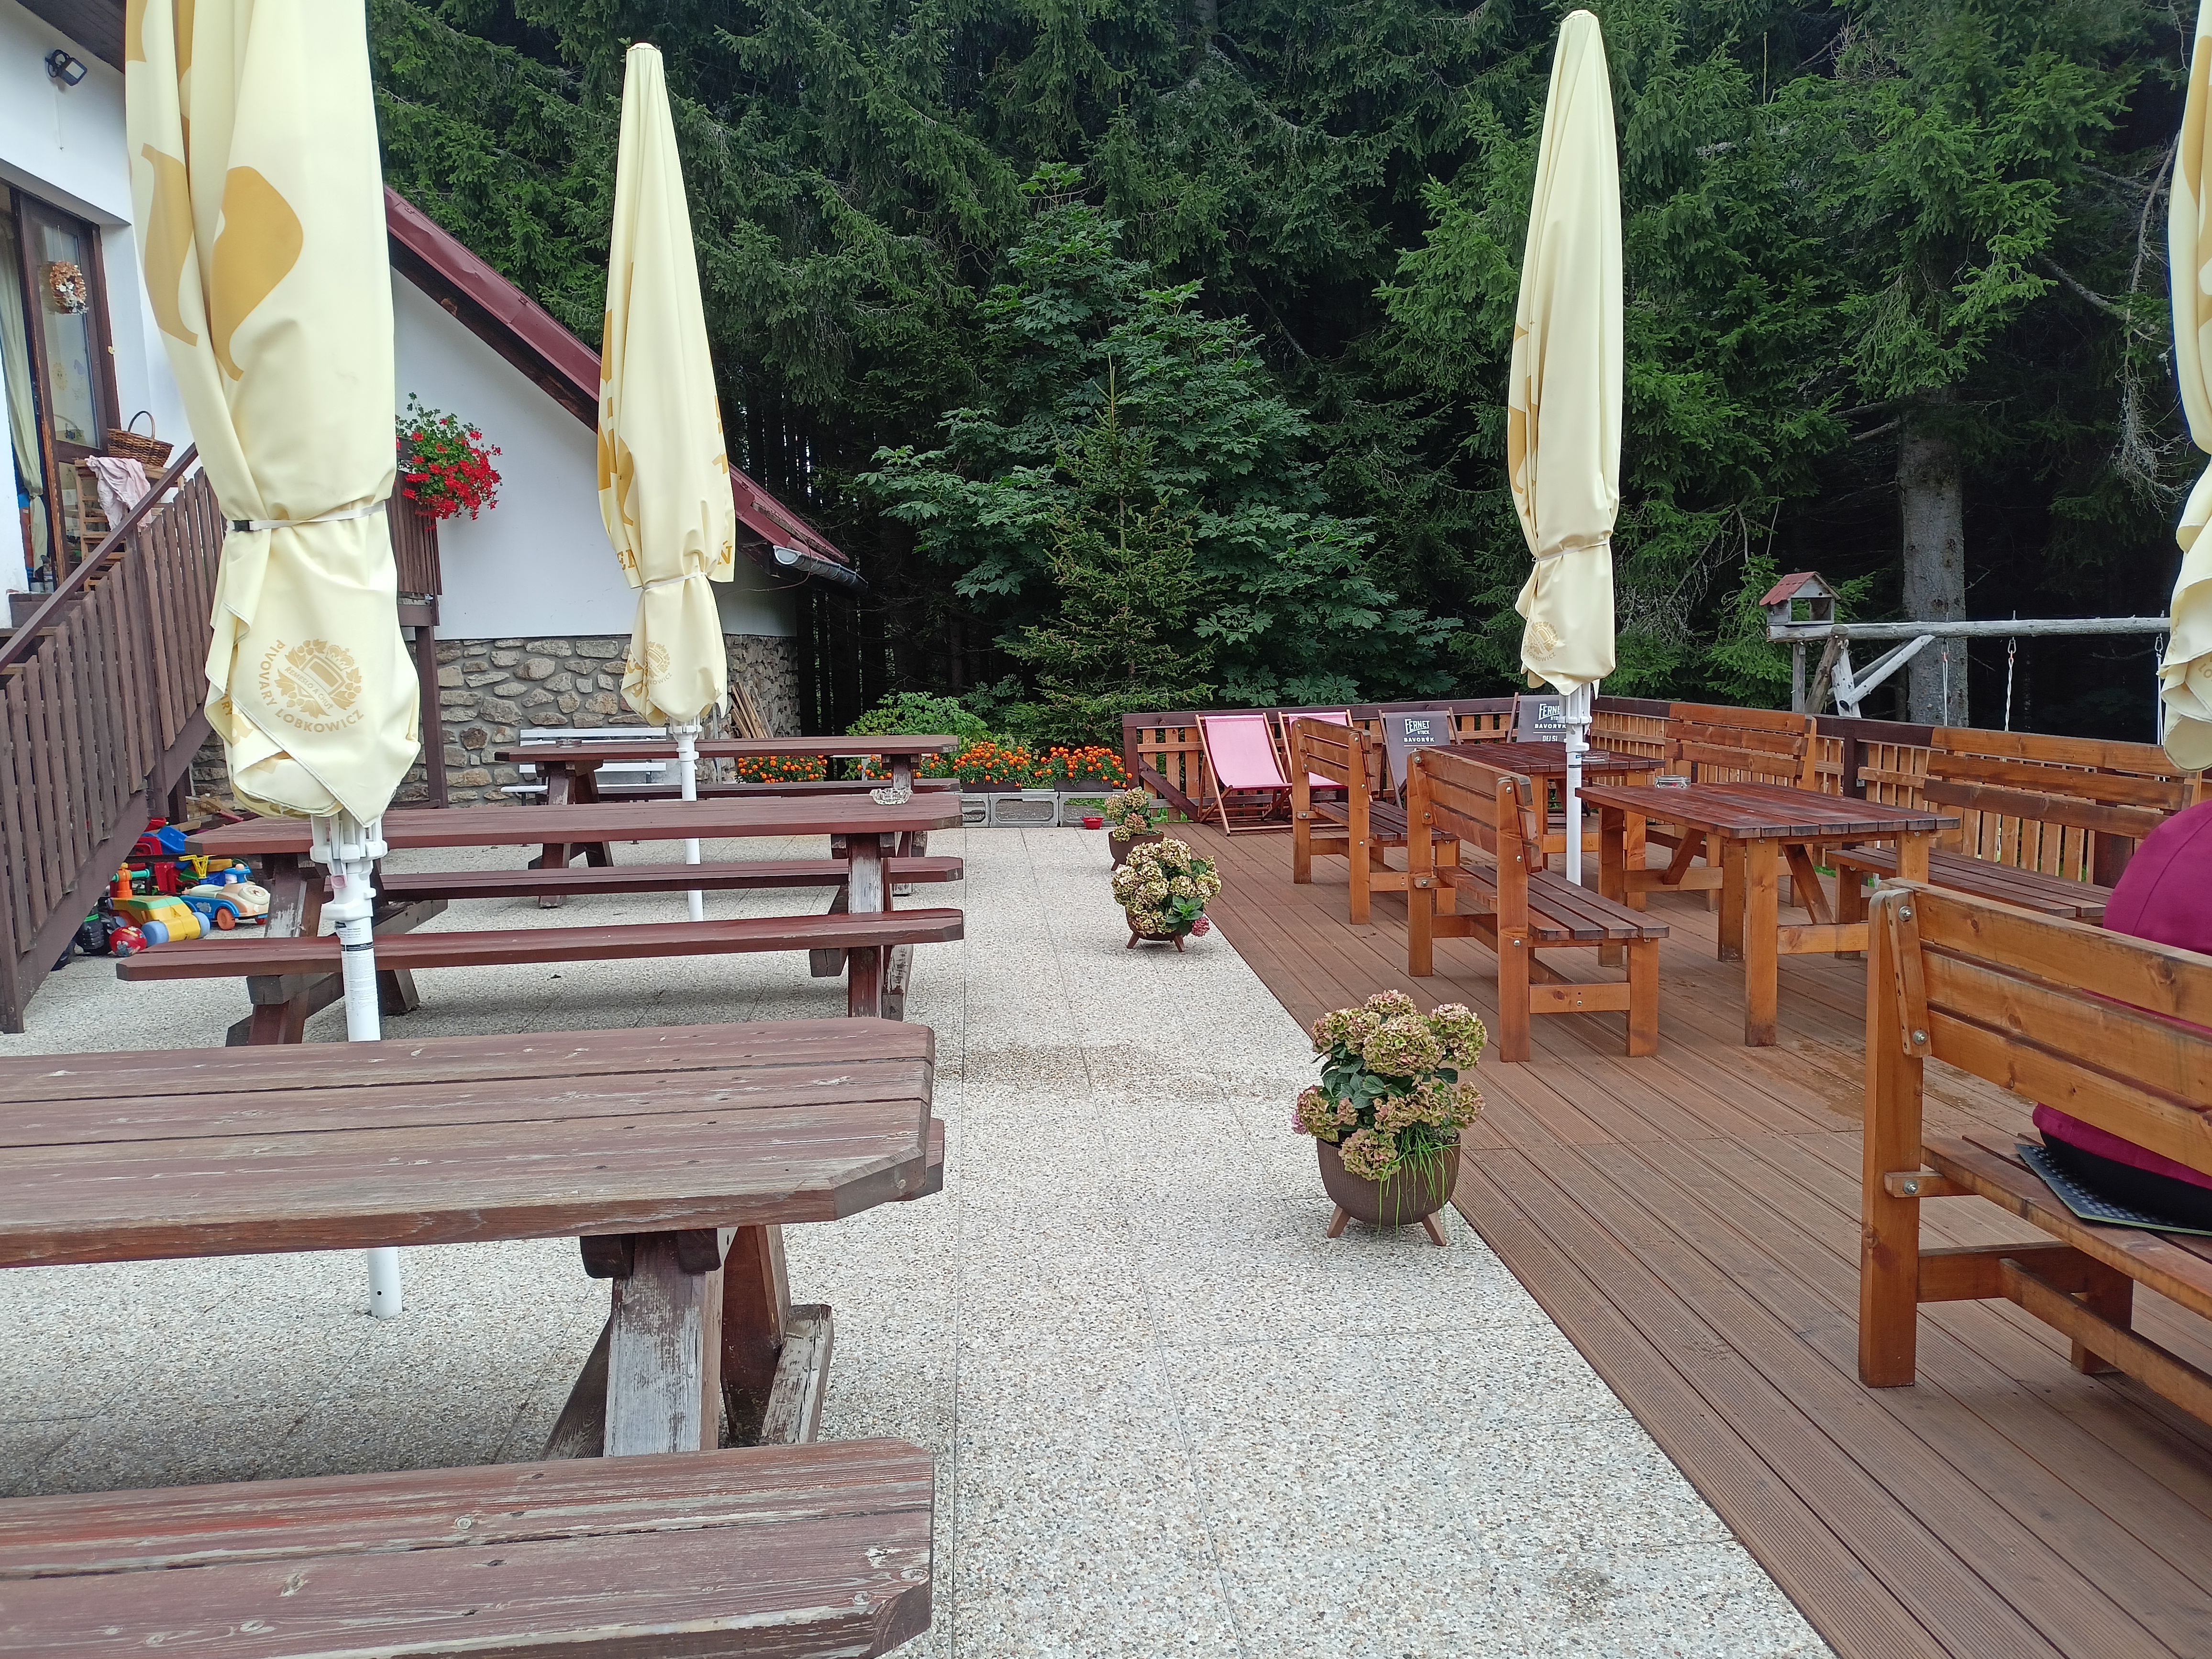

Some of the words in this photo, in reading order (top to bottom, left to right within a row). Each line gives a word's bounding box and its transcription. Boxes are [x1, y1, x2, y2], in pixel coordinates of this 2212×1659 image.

[259, 639, 286, 706] PIVOVARY
[649, 672, 672, 685] KOWICZ
[1538, 704, 1559, 720] FERNE
[275, 708, 364, 733] LOBKOWICZ
[1405, 719, 1430, 735] FERNET
